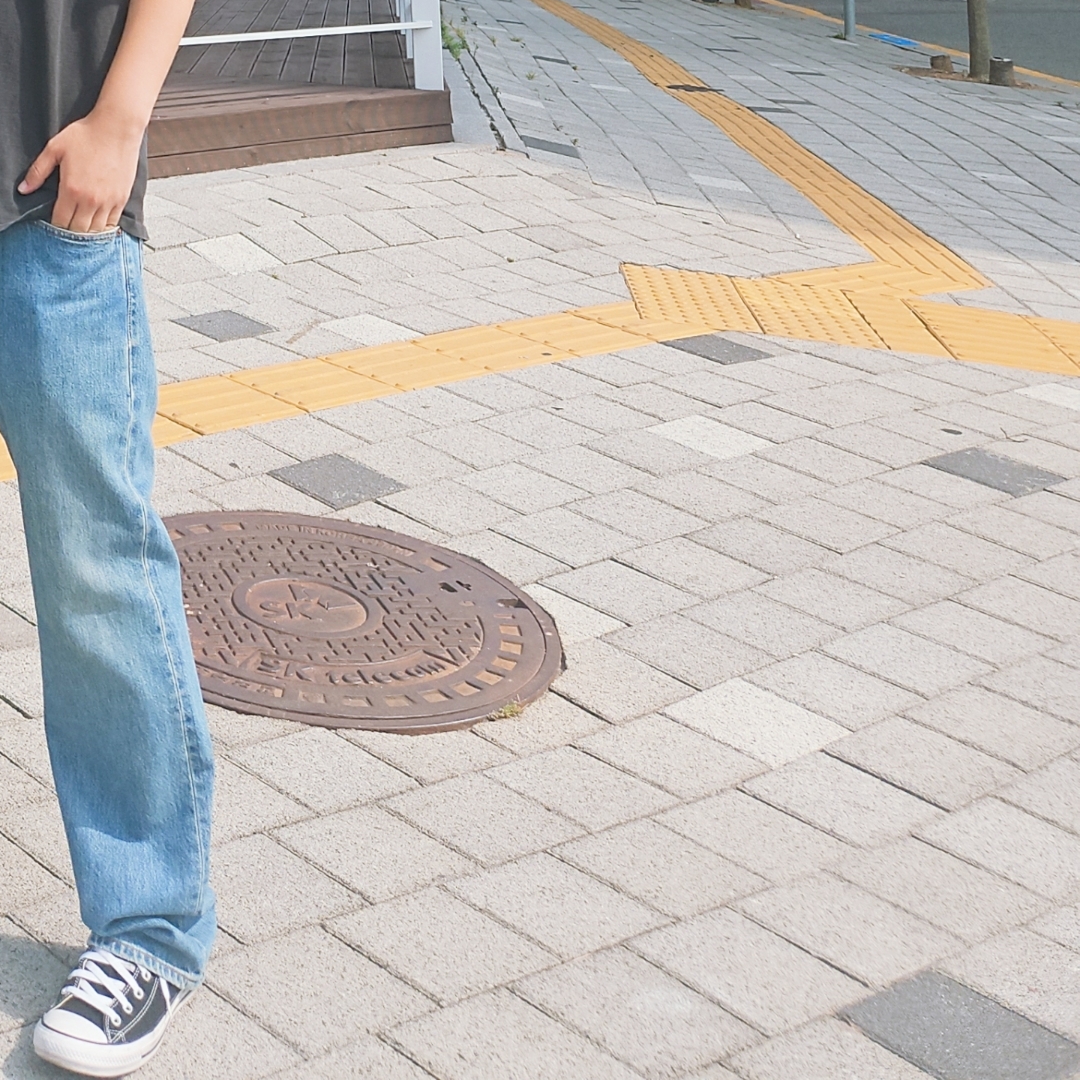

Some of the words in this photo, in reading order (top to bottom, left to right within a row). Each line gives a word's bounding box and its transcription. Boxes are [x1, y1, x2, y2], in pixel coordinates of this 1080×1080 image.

[259, 600, 313, 620] SK
[257, 657, 314, 683] SK
[326, 661, 447, 685] telecom
